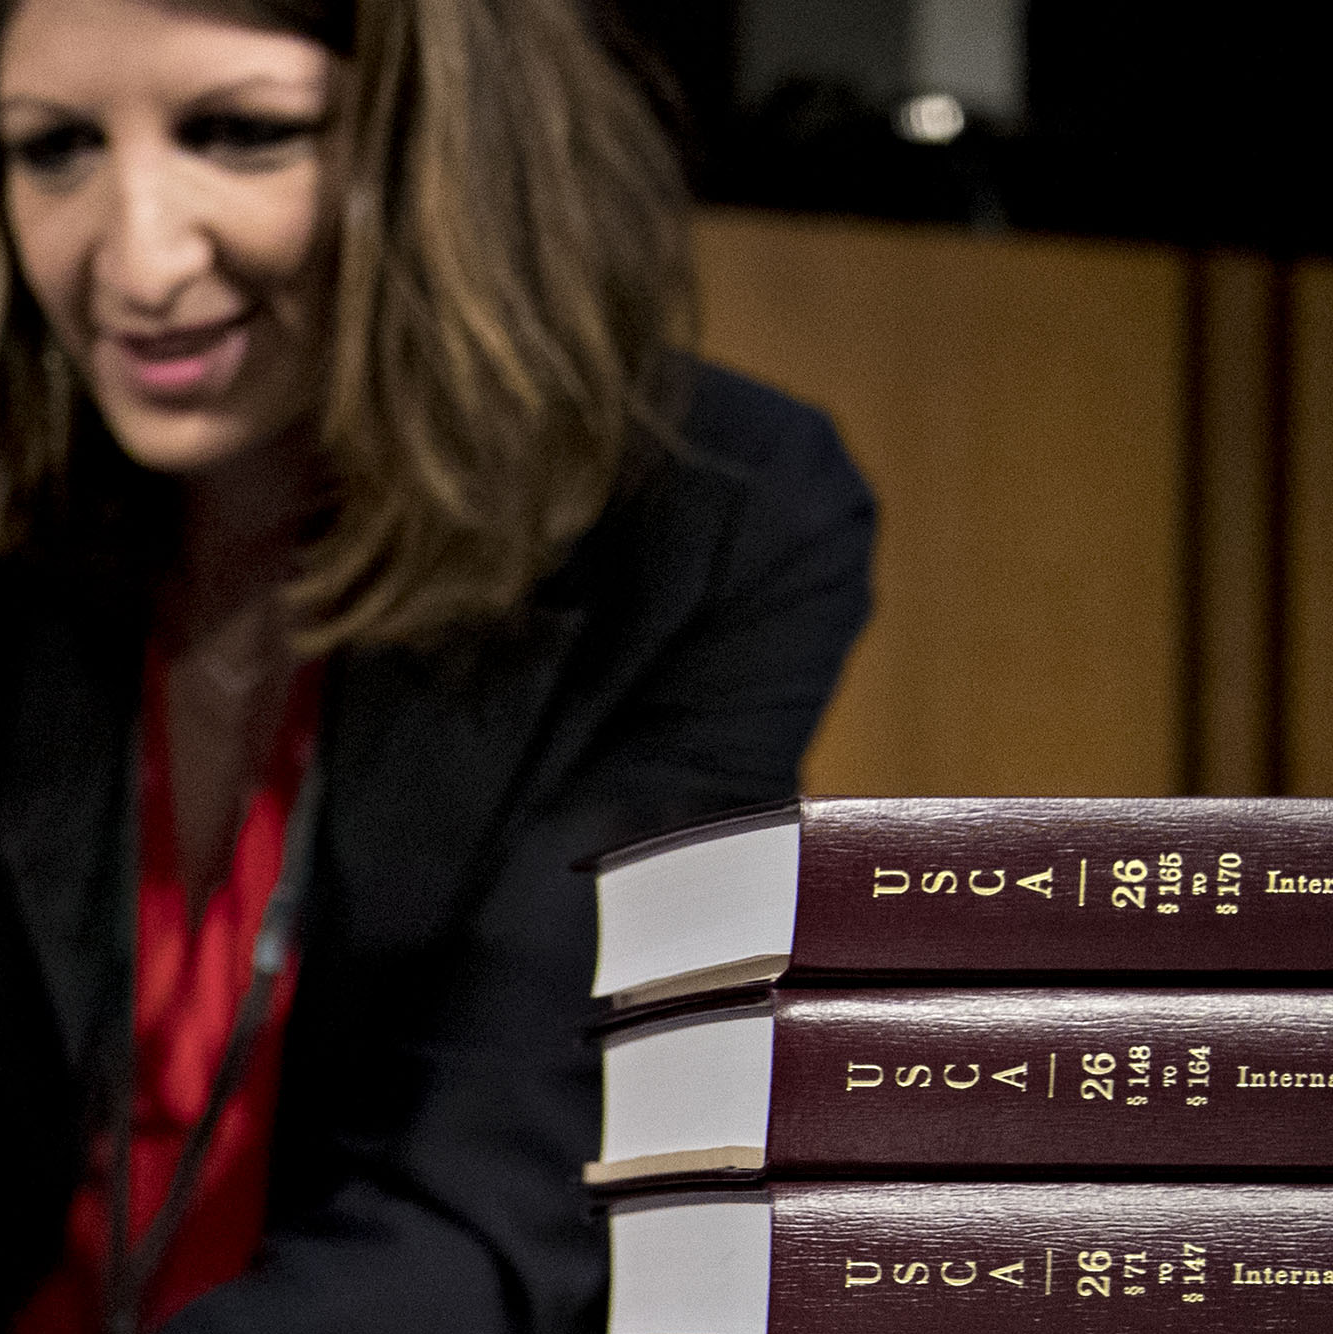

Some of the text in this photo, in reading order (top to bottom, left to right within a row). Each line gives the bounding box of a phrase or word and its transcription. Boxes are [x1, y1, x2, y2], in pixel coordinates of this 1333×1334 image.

[1110, 858, 1148, 910] 26
[1080, 1052, 1116, 1101] 26
[1076, 1250, 1113, 1297] 26
